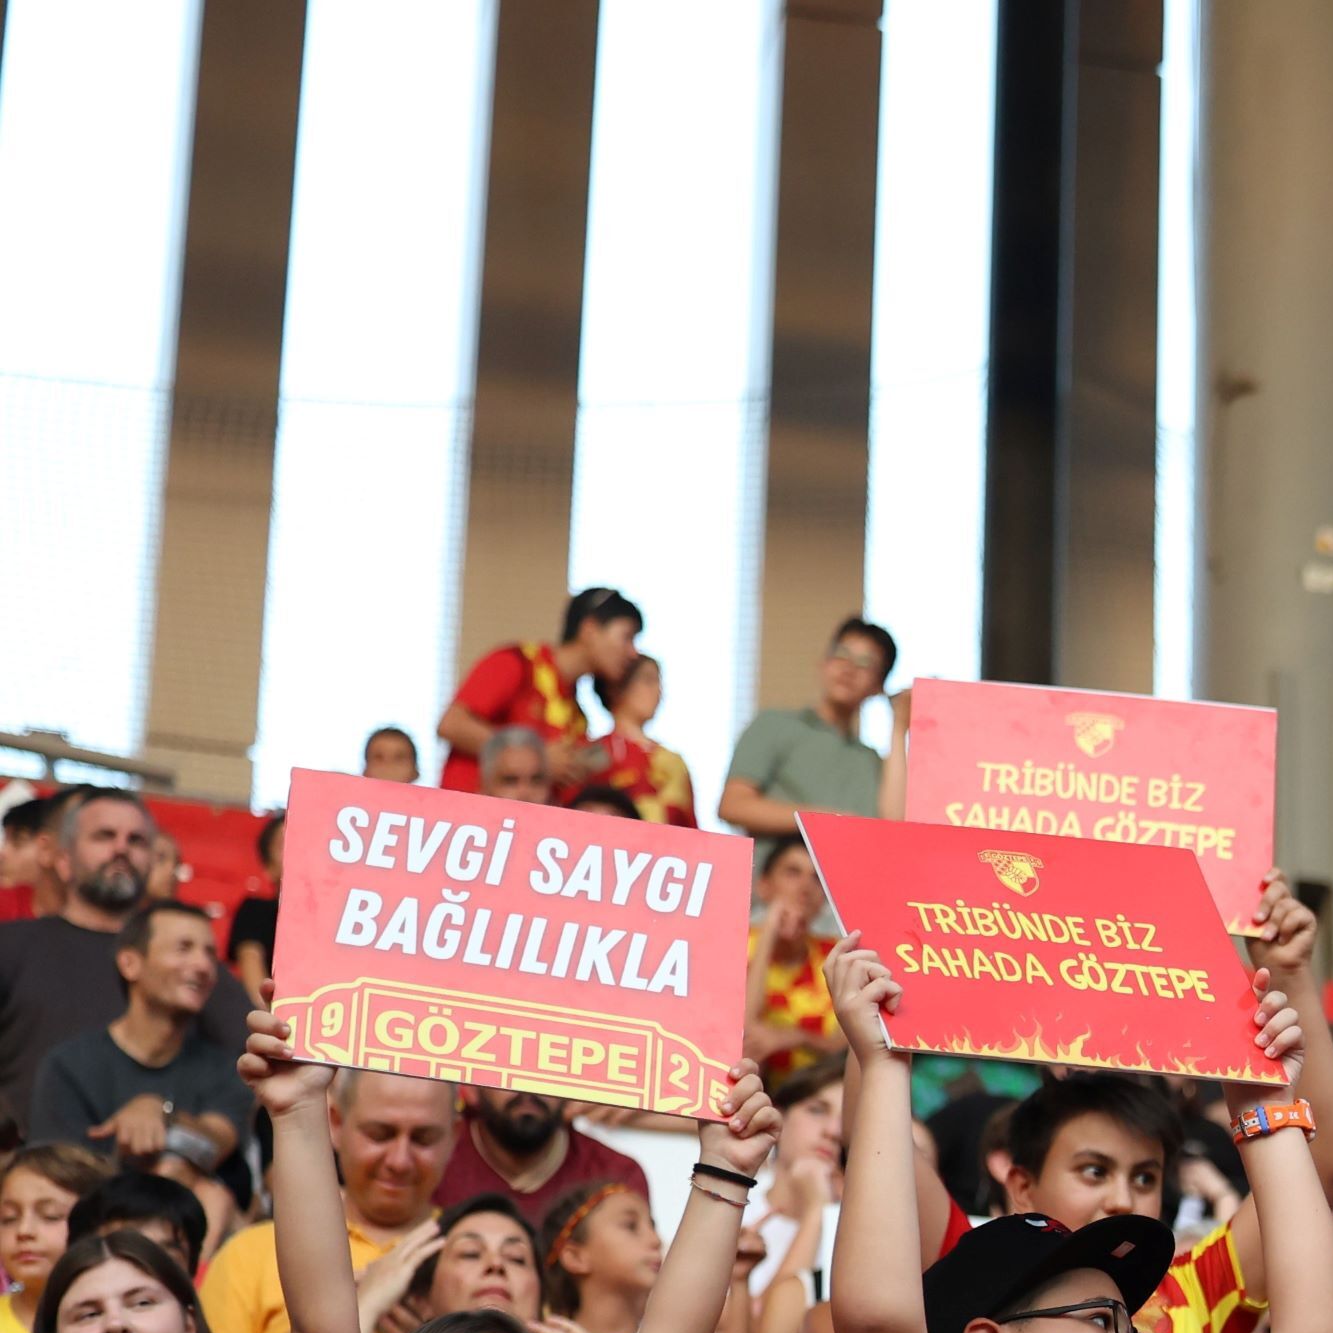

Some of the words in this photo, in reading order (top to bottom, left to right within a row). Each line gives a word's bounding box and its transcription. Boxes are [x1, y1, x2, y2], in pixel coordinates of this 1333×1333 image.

[977, 760, 1140, 806] TRİBÜNDE
[1147, 774, 1206, 812] BİZ
[329, 806, 517, 886] SEVGİ
[529, 837, 713, 917] SAYGI
[1093, 812, 1237, 860] GÖZTEPE
[335, 888, 689, 997] BAĞLILIKLA
[907, 899, 1092, 947] TRİBÜNDE
[1095, 913, 1163, 953] BİZ
[896, 943, 1054, 987] SAHADA
[1059, 952, 1216, 1003] GÖZTEPE
[374, 1005, 640, 1083] GÖZTEPE
